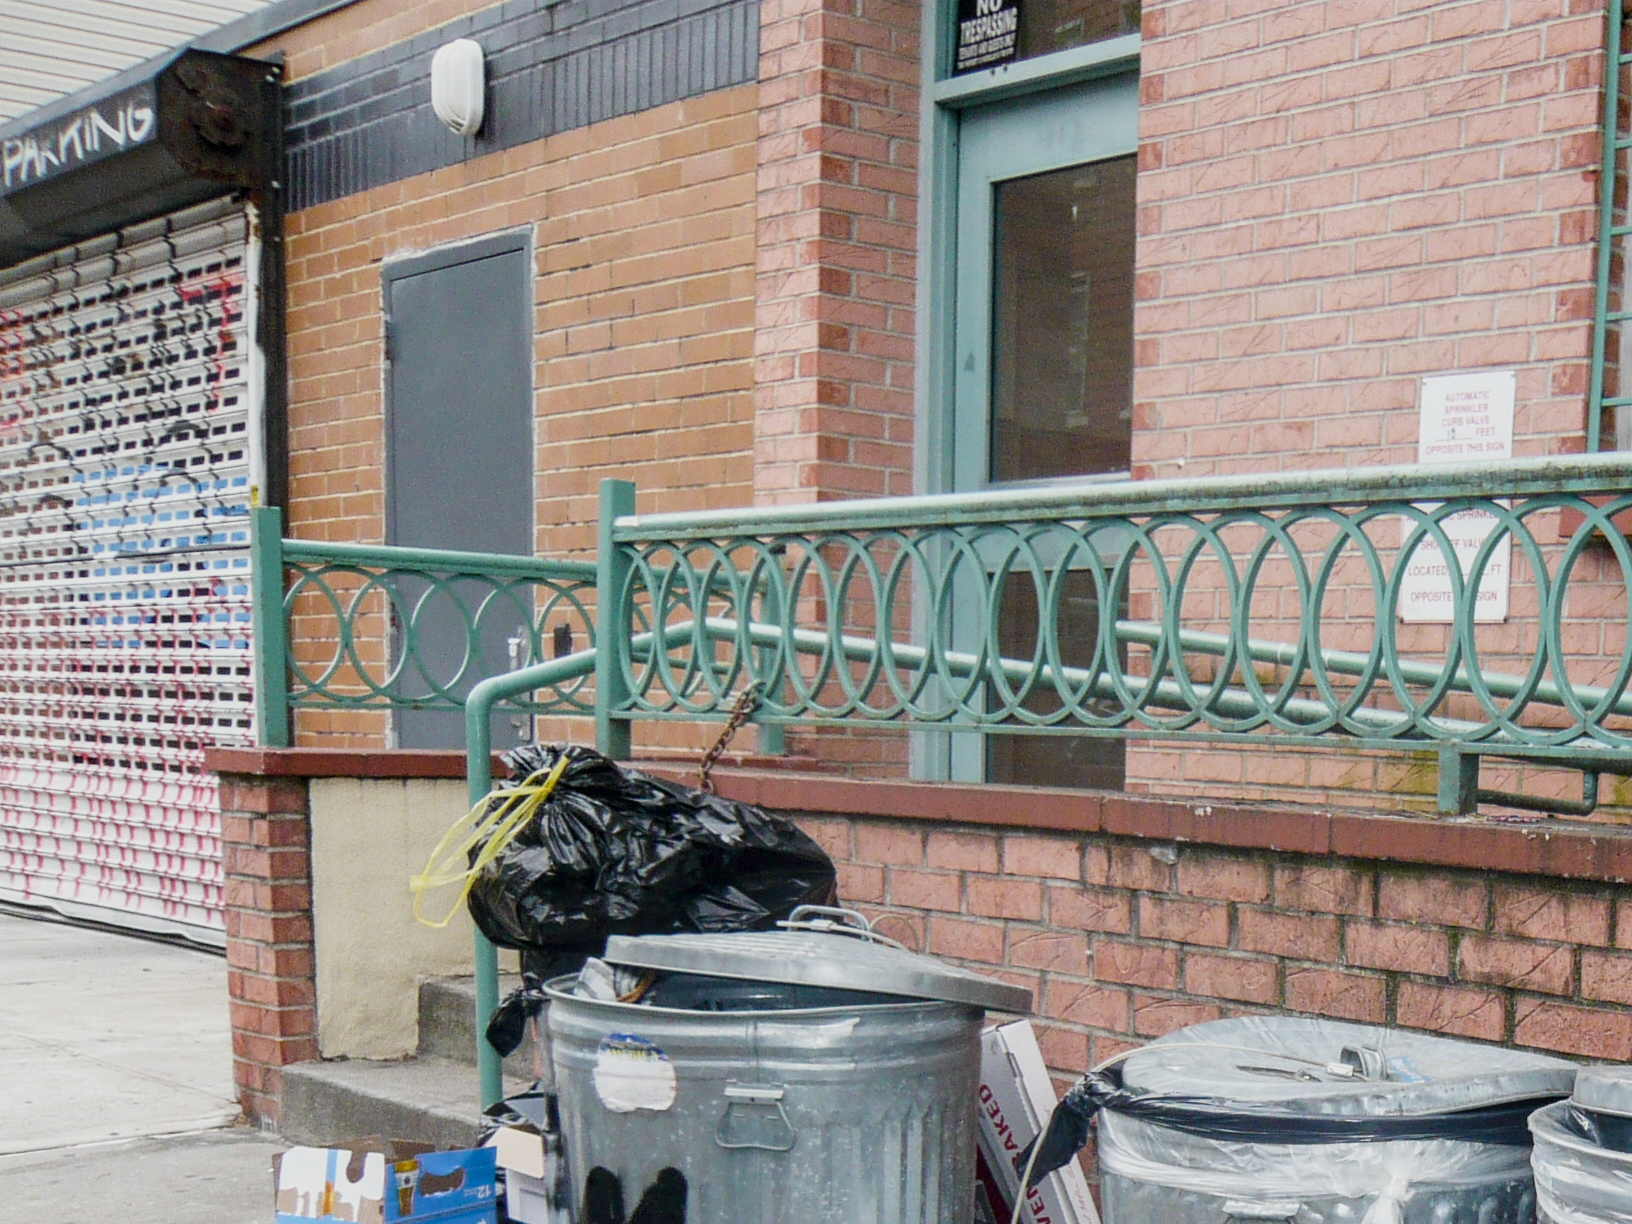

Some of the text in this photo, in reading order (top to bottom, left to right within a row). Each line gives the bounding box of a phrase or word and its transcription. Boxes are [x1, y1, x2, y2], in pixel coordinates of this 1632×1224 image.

[1445, 390, 1490, 402] AUTOMATIC
[1444, 403, 1488, 415] SPRINKLER
[1441, 415, 1491, 427] CURB VALVE
[1475, 426, 1496, 437] FEET
[1425, 441, 1505, 455] OPPOSITE THIS SIGN
[1408, 565, 1448, 576] LOCATED
[1410, 591, 1453, 602] OPPOSITE
